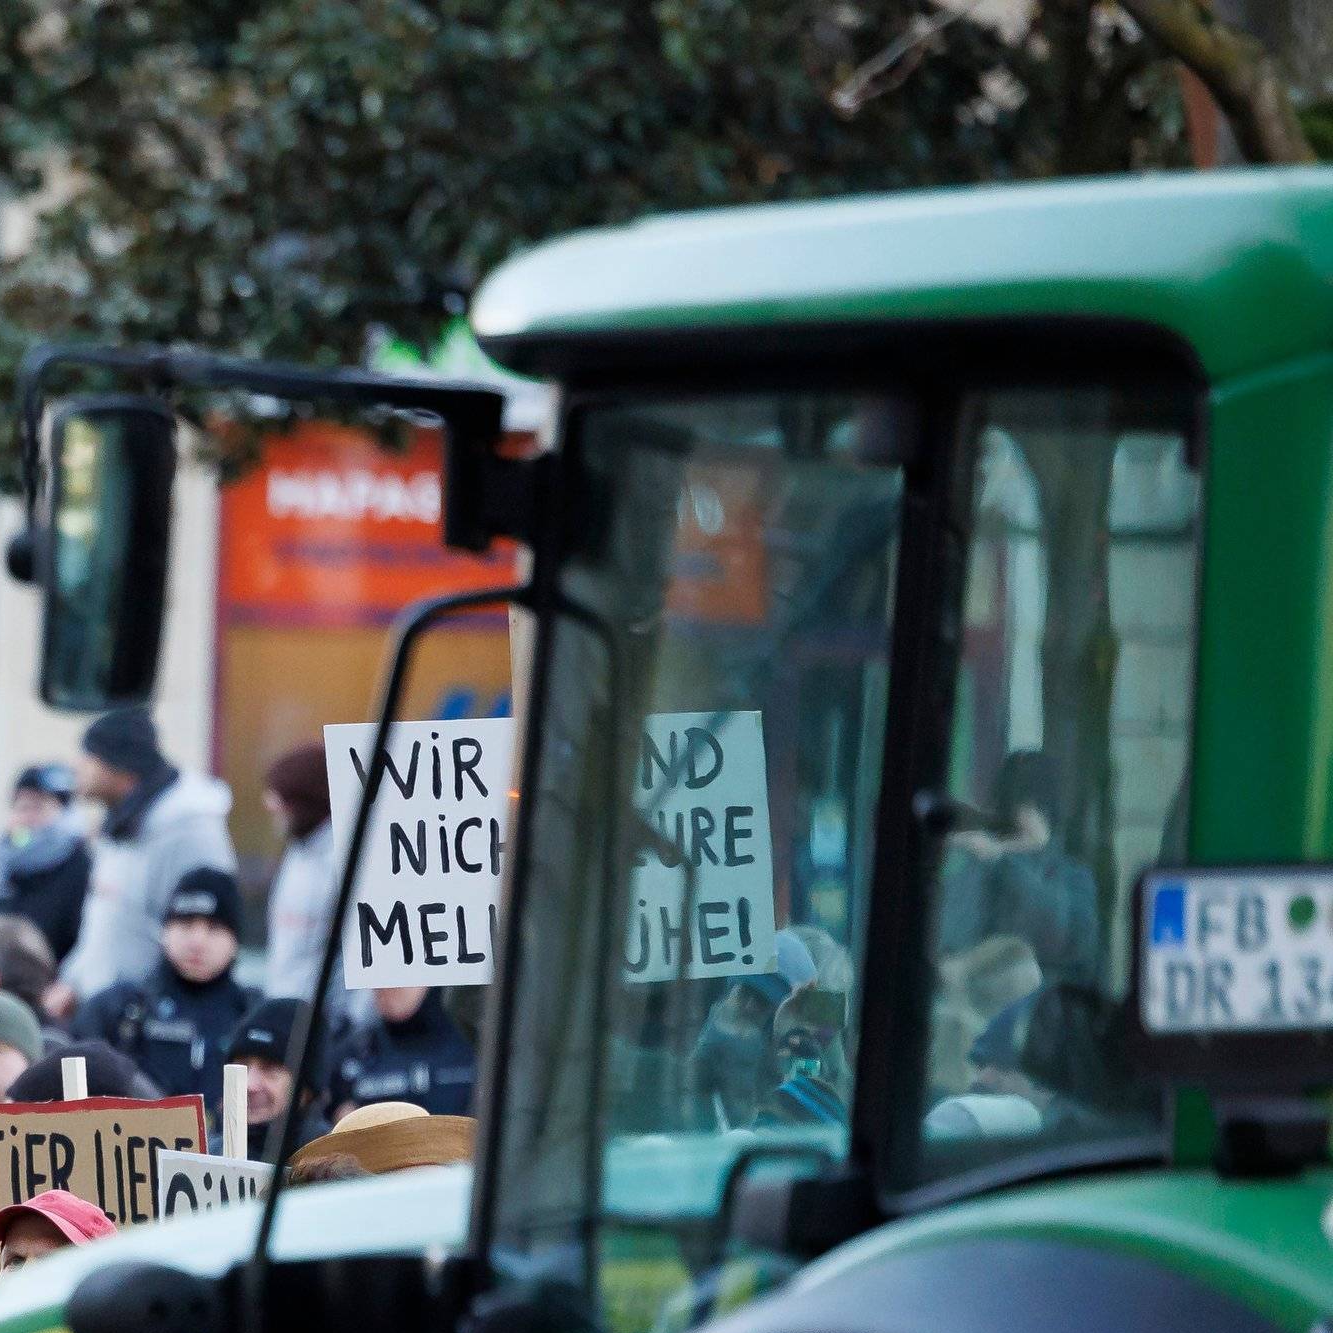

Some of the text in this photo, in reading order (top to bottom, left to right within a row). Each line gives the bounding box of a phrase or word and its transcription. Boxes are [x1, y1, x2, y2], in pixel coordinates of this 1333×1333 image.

[641, 727, 724, 790] ND
[635, 806, 756, 868] URE
[1261, 955, 1333, 1018] 13
